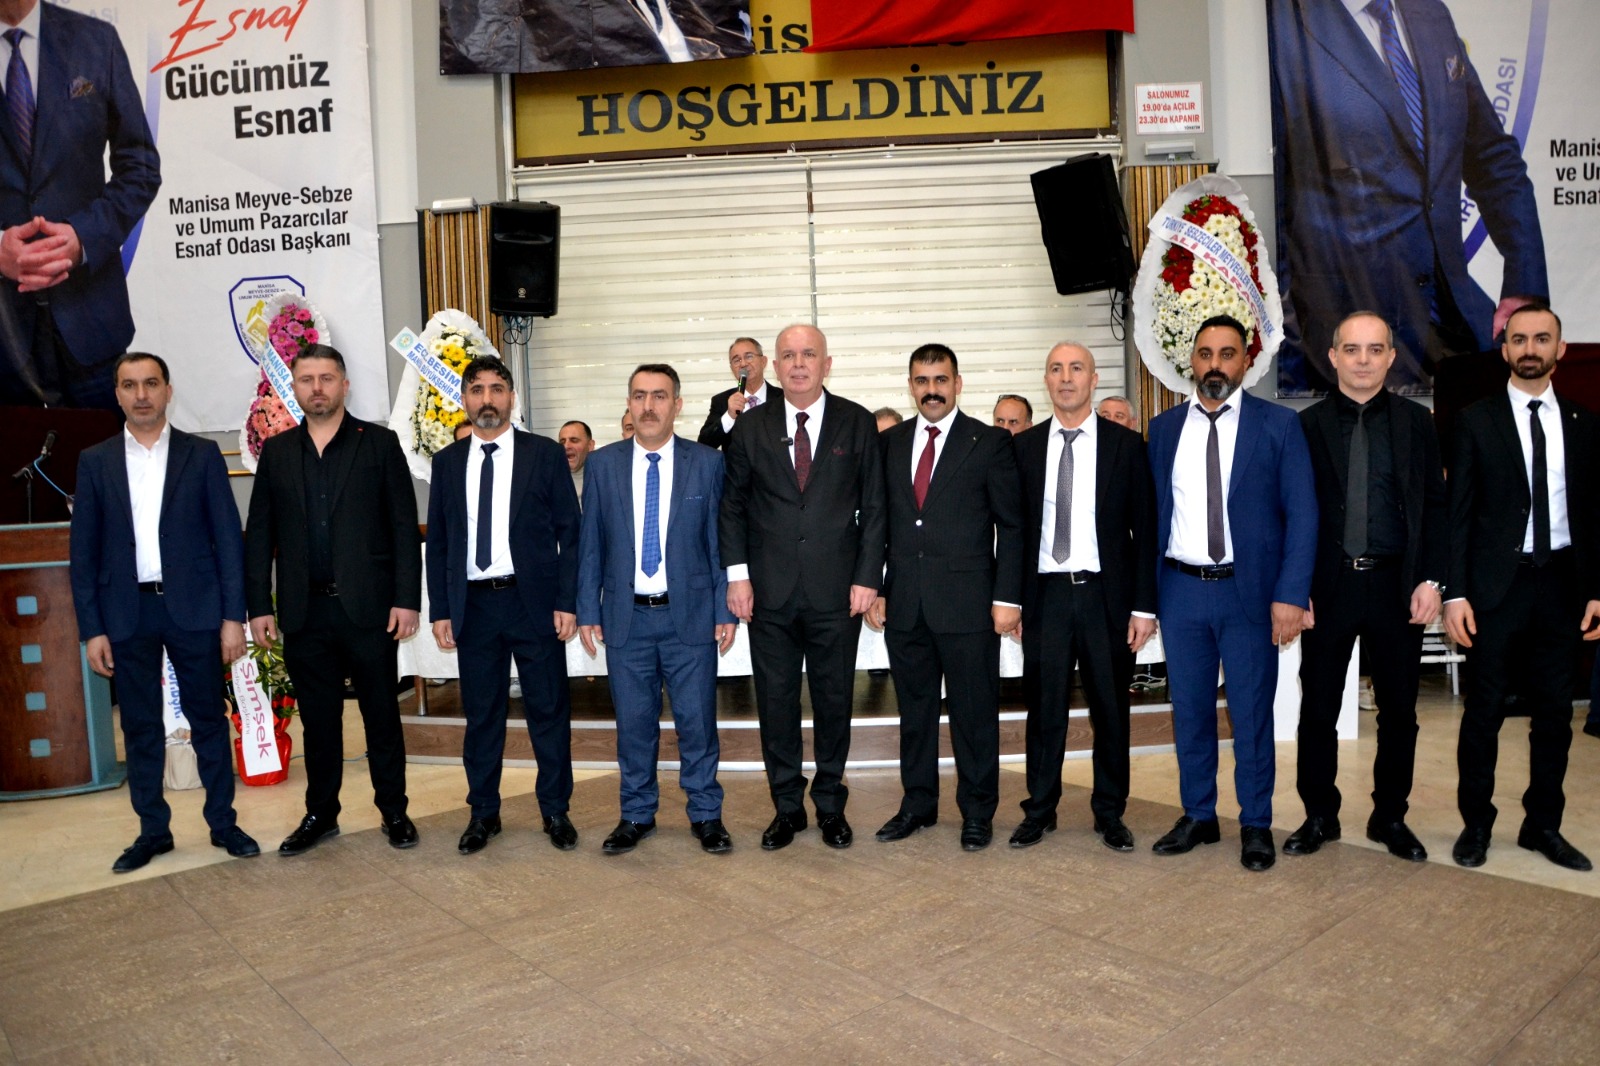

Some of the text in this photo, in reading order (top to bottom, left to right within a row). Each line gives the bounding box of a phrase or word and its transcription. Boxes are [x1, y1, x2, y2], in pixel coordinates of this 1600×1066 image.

[165, 53, 330, 101] Gücümüz
[576, 60, 1045, 142] HOŞGELDİNİZ
[1142, 102, 1196, 113] 19.00'da AÇILIR
[233, 98, 334, 139] Esnaf
[1139, 114, 1200, 124] 23.30'da KAPANIR
[1555, 167, 1577, 181] ve
[169, 186, 353, 215] Manisa Meyve-Sebze
[1553, 187, 1600, 205] Esna
[175, 208, 349, 236] ve Umum Pazarcılar
[175, 231, 351, 259] Esnaf Odası Başkanı
[1169, 233, 1199, 250] ALİ
[267, 348, 290, 383] MANİSA
[427, 356, 461, 388] BESİM
[240, 662, 272, 759] Şimşek
